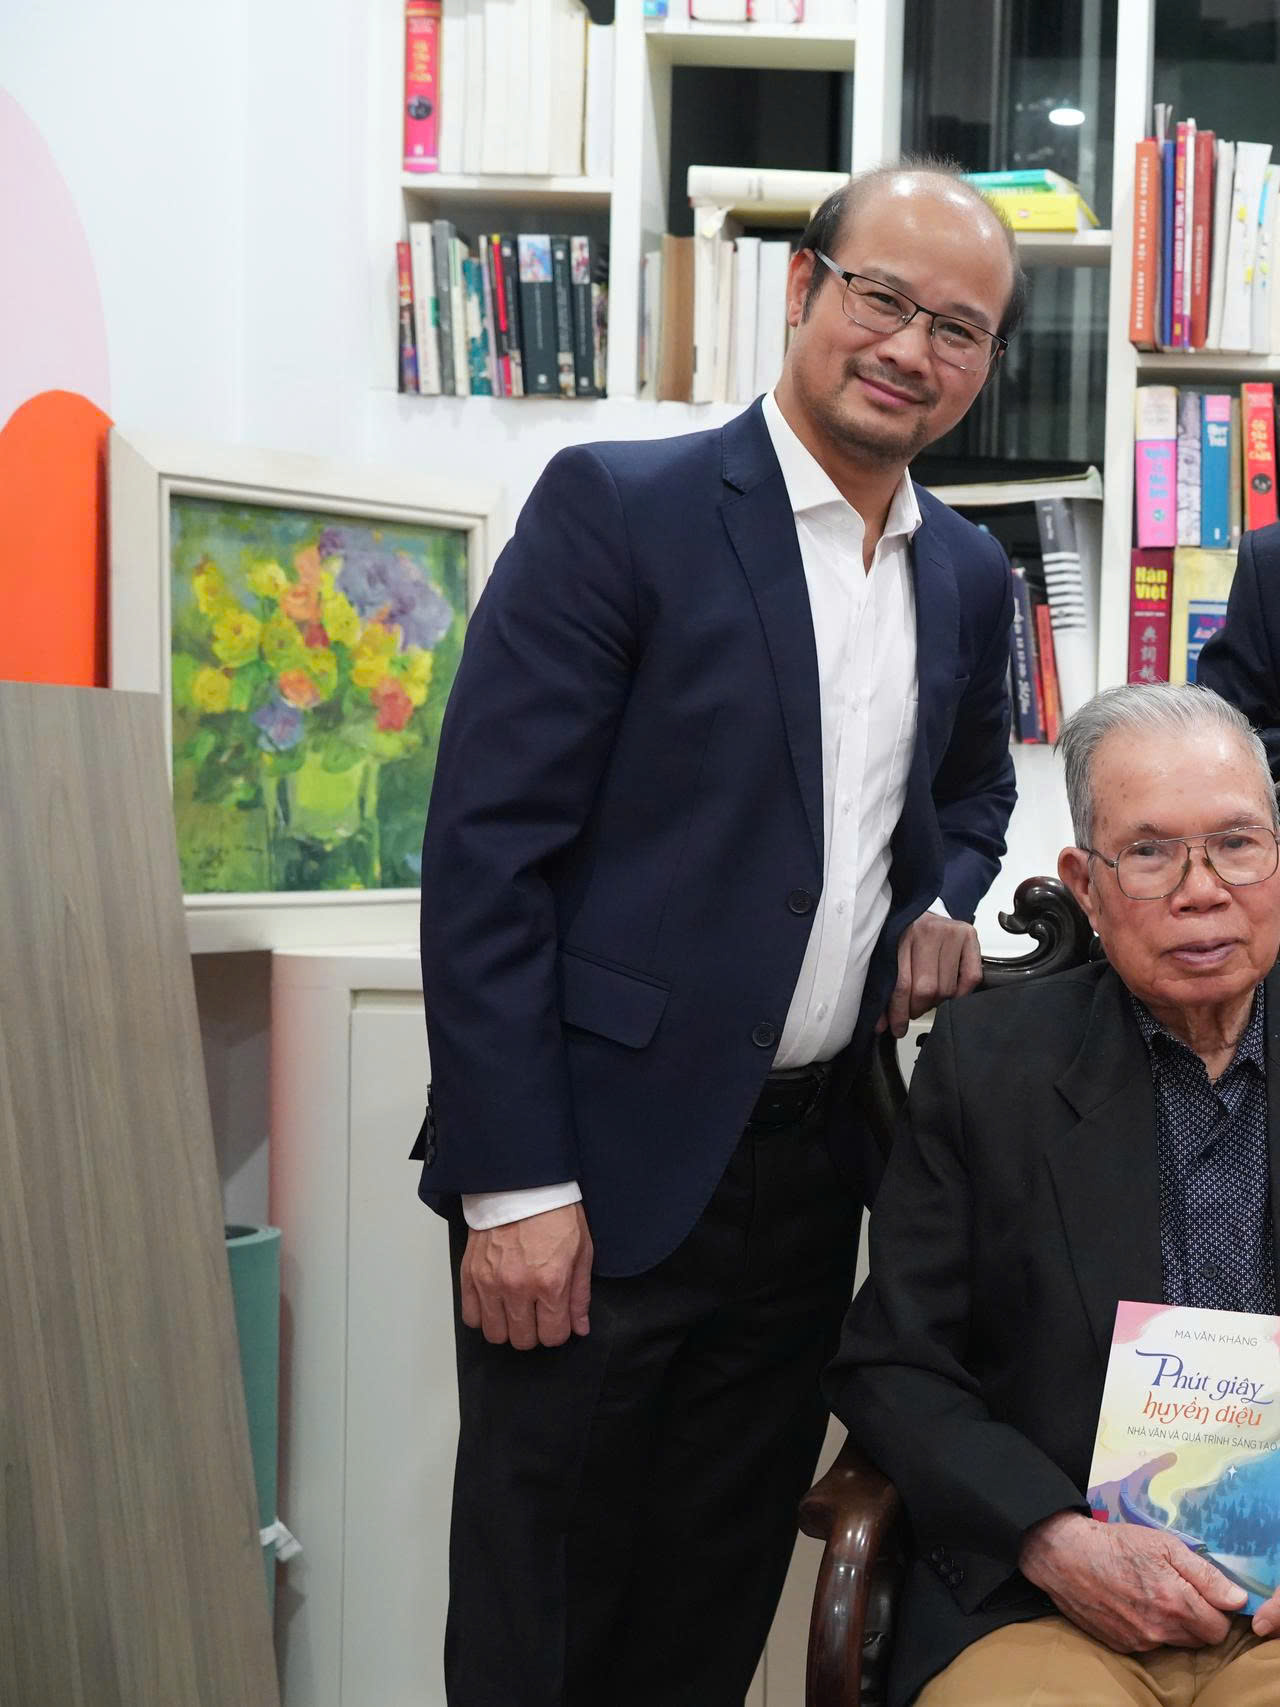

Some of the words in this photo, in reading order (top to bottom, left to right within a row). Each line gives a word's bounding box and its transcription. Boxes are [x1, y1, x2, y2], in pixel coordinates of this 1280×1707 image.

[1135, 270, 1145, 330] AMSTERDAM
[1134, 566, 1168, 583] Hán
[1134, 584, 1168, 601] Việt
[1174, 1330, 1191, 1339] MA
[1193, 1331, 1216, 1342] VĂN
[1219, 1334, 1258, 1347] KHÁNG
[1135, 1348, 1211, 1391] Phút
[1208, 1376, 1274, 1405] giây
[1142, 1391, 1209, 1424] huyền
[1215, 1405, 1262, 1428] diệu
[1127, 1425, 1146, 1436] NHÀ
[1148, 1427, 1167, 1438] VĂN
[1168, 1429, 1180, 1439] VÀ
[1181, 1431, 1202, 1443] QUÁ
[1203, 1433, 1230, 1445] TRÌNH
[1231, 1436, 1257, 1449] SÁNG
[1258, 1440, 1278, 1452] TẠO
